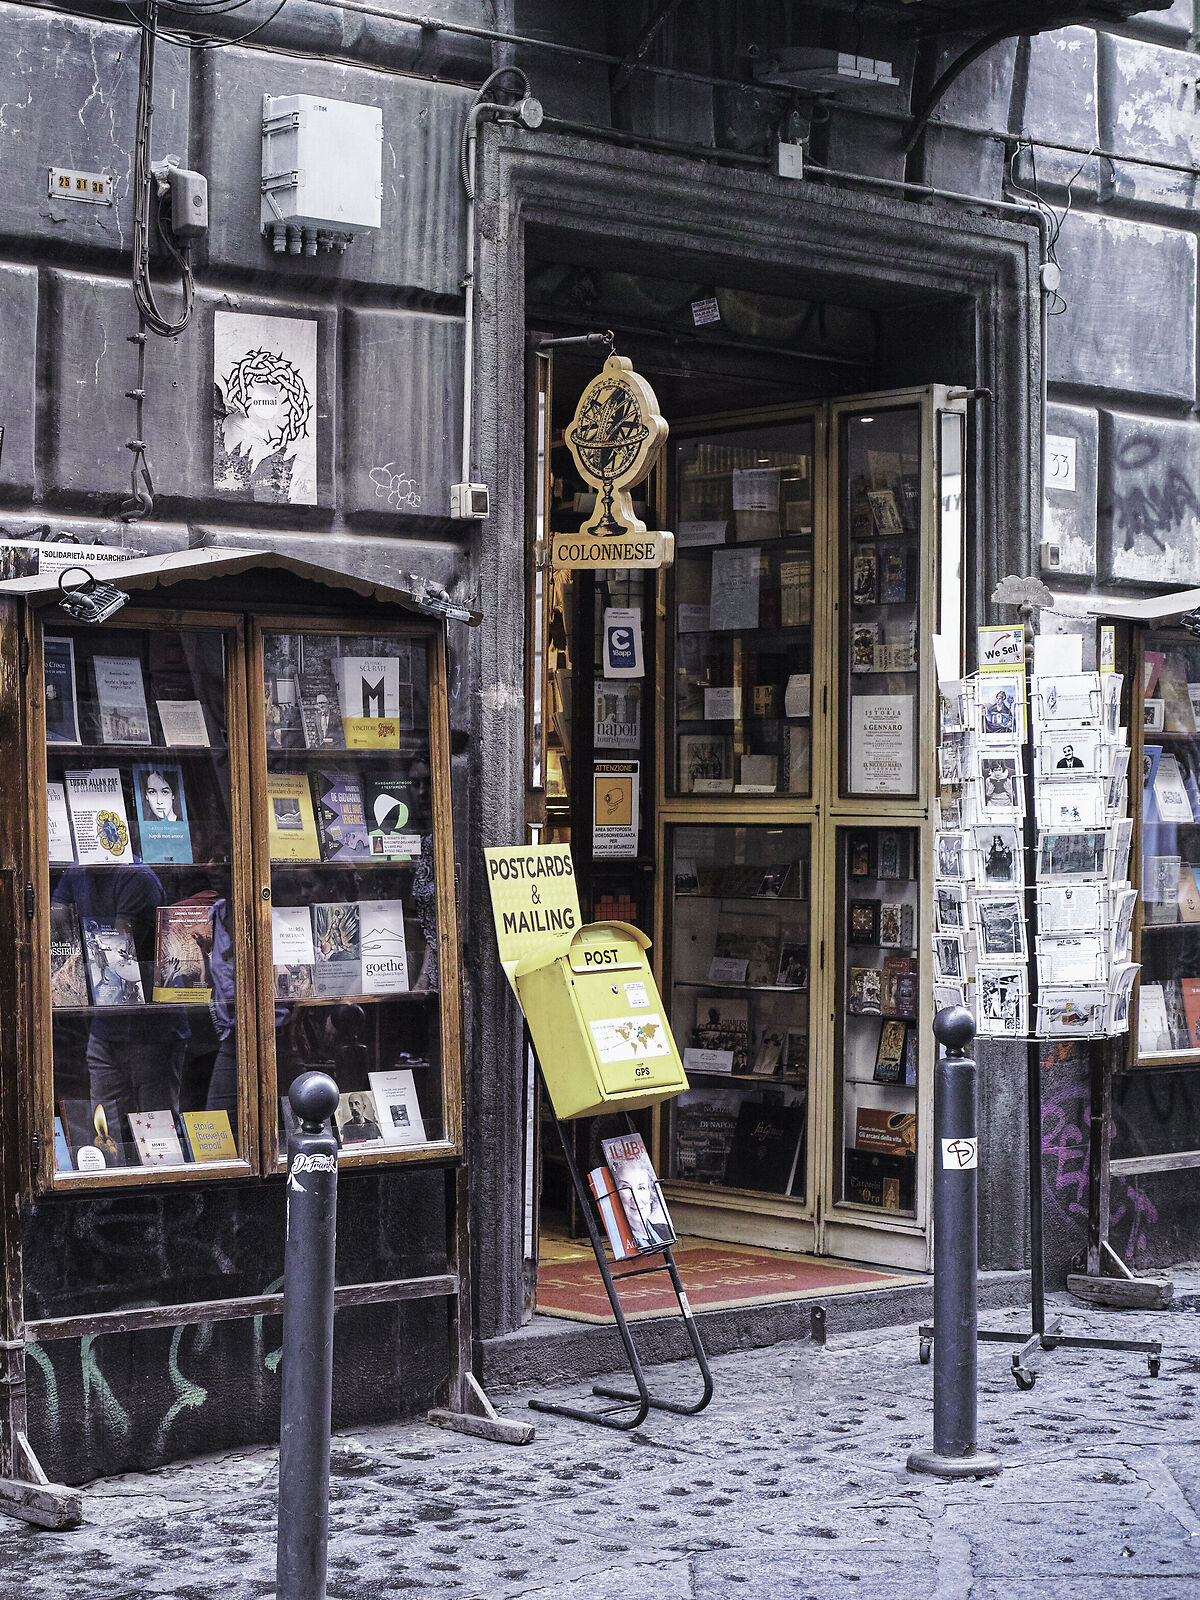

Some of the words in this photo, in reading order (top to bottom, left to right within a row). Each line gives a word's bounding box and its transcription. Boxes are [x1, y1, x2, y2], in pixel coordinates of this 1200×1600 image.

[59, 176, 71, 187] 25
[76, 178, 88, 189] 31
[252, 396, 278, 406] ormai
[1049, 452, 1070, 479] 33
[557, 543, 656, 562] COLONNESE
[984, 649, 1001, 660] We
[1001, 643, 1019, 655] Sell
[49, 661, 66, 669] Croce
[361, 675, 386, 718] M
[596, 721, 637, 737] napoli
[595, 764, 633, 772] ATTENZIONE
[89, 778, 108, 786] ALLAN
[107, 777, 119, 786] POE
[330, 792, 338, 802] DE
[489, 854, 574, 881] POSTCARDS
[531, 884, 542, 905] &
[503, 907, 575, 934] MAILING
[584, 949, 619, 966] POST
[365, 959, 405, 977] goethe
[634, 1066, 651, 1077] GPS
[193, 1122, 215, 1131] storia
[220, 1131, 228, 1139] di
[199, 1142, 222, 1151] napoli
